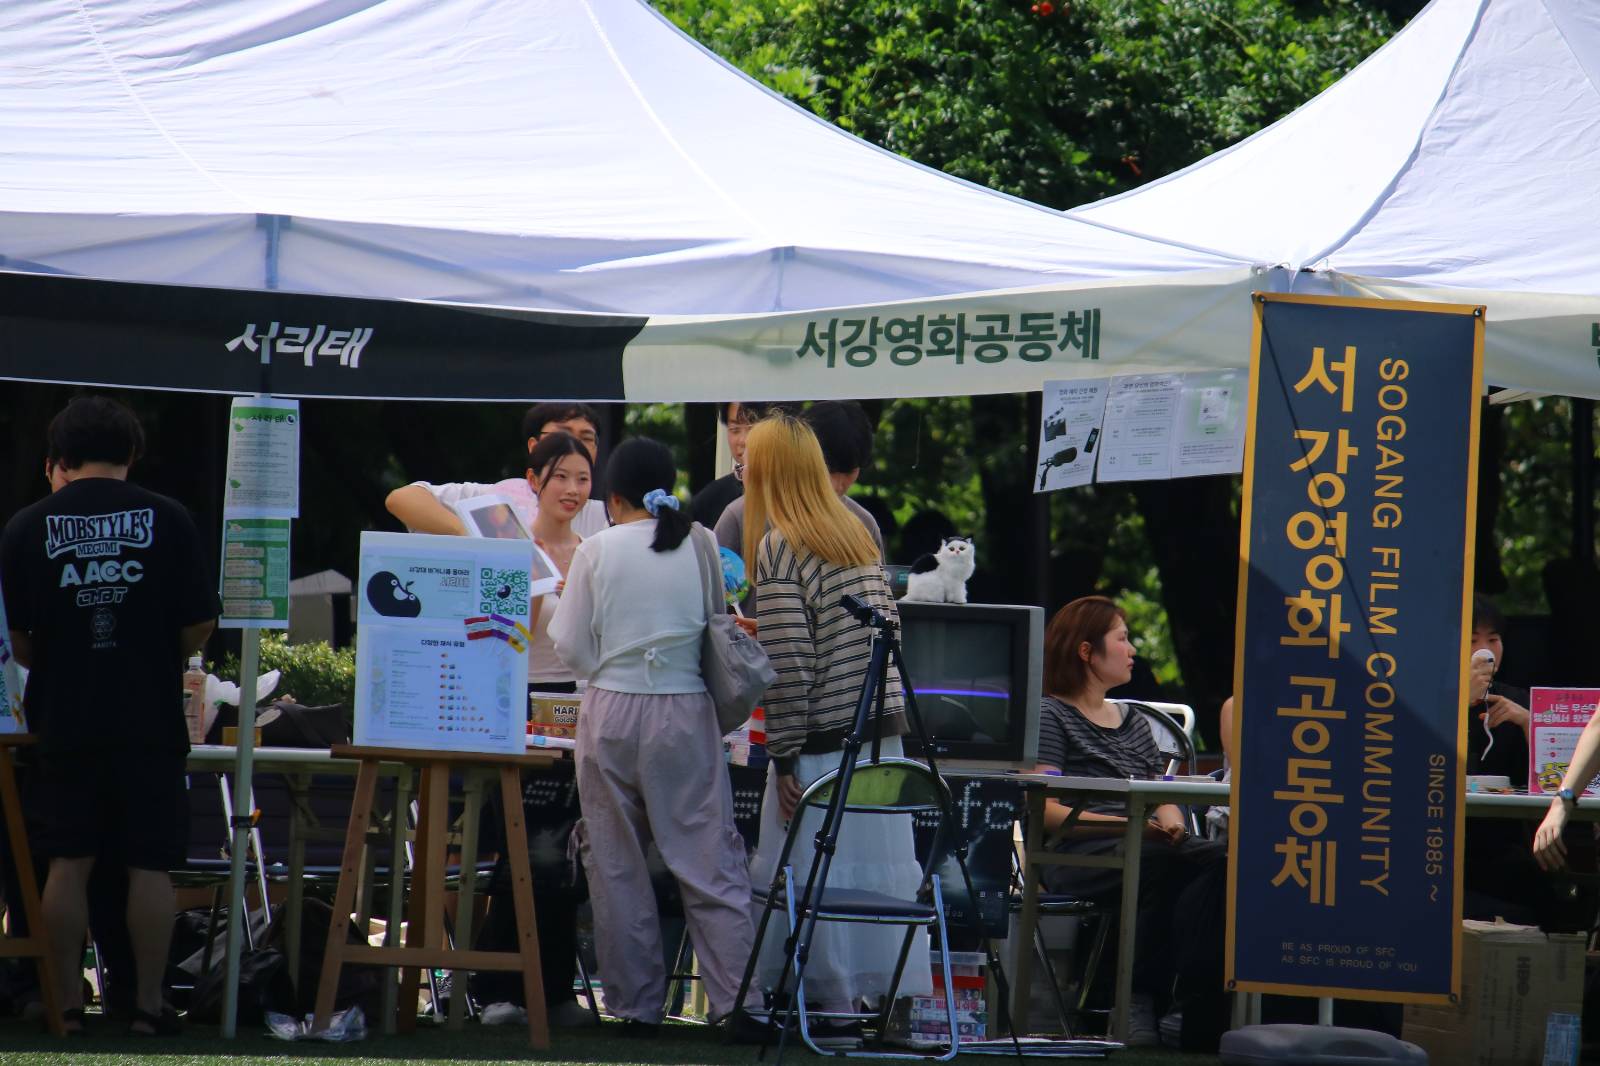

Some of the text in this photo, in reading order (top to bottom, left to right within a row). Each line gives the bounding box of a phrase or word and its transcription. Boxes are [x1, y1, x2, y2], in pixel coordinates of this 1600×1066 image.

[224, 321, 374, 368] 서리태
[796, 308, 1101, 368] 서강영화공동체
[46, 508, 154, 558] MOBSTYLES
[77, 542, 119, 556] MEGUMI
[1271, 345, 1359, 907] 서강영화공동체
[1359, 357, 1410, 897] SOGANG FILM COMMUNITY
[553, 705, 578, 715] HARI
[1426, 753, 1446, 819] SINCE
[1424, 826, 1444, 876] 1985
[1281, 954, 1418, 973] AS SFC IS PROUD OF YOU
[1299, 943, 1312, 952] AS
[1318, 944, 1351, 955] PROUD
[1356, 945, 1370, 955] OF
[1375, 946, 1396, 958] SFC
